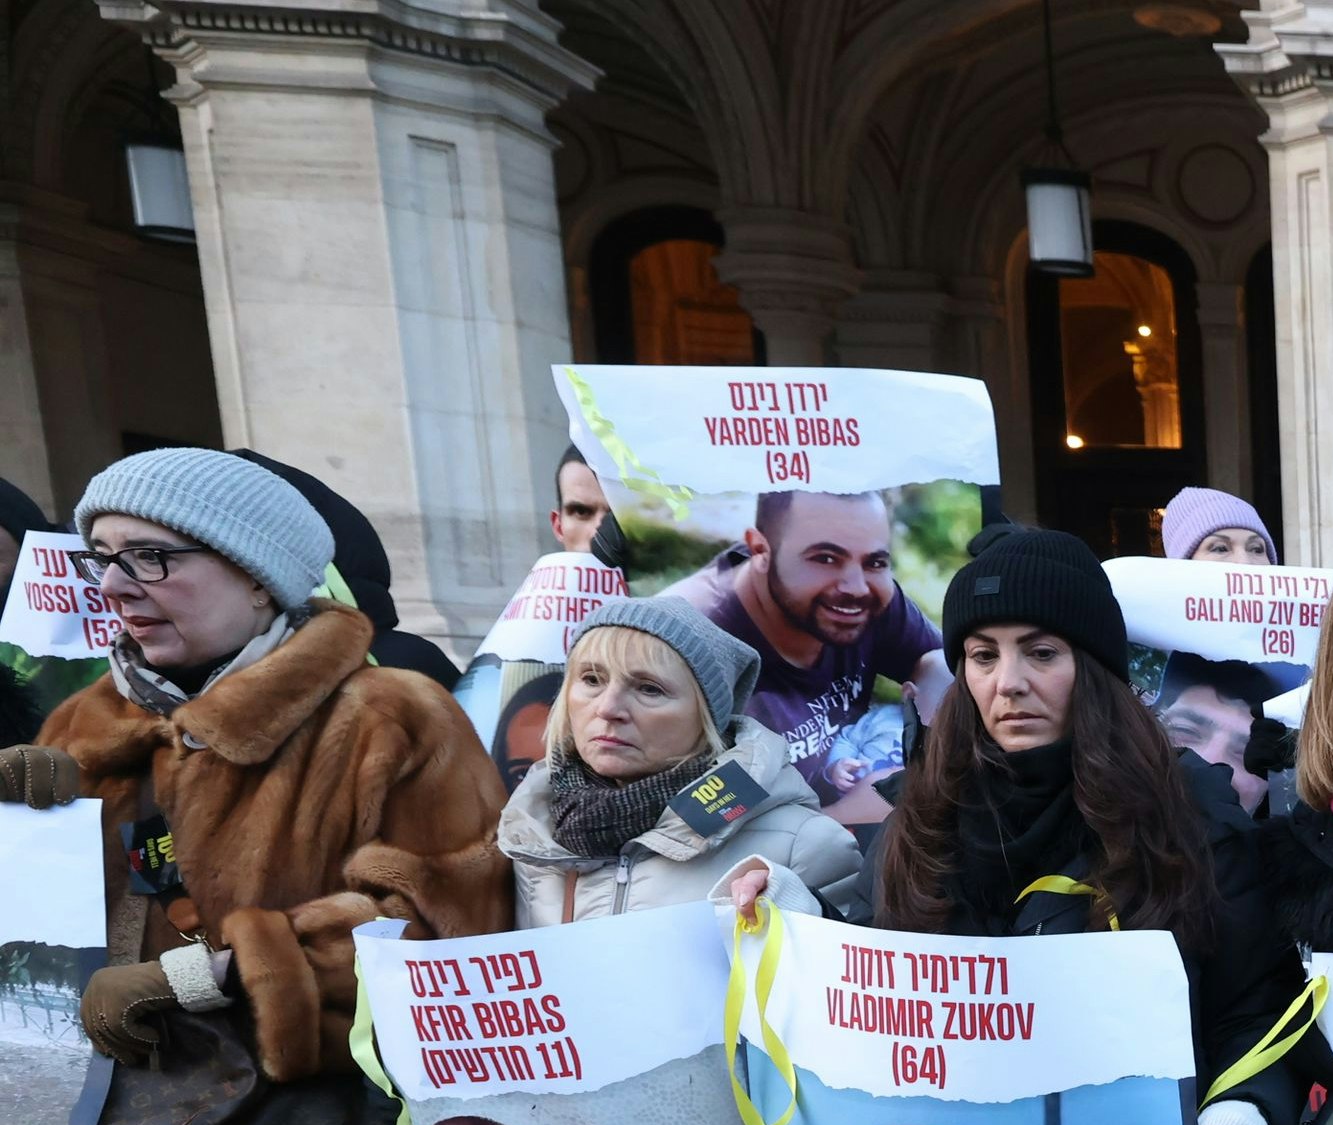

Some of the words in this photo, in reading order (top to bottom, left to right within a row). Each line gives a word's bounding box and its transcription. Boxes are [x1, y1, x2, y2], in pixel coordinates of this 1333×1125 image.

[728, 383, 780, 411] ביבס
[785, 383, 827, 414] ירדן
[704, 417, 789, 446] YARDEN
[796, 418, 860, 446] BIBAS
[766, 450, 810, 484] (34)
[24, 581, 80, 614] YOSSI
[1225, 572, 1264, 596] ברמן
[1303, 576, 1329, 599] גלי
[1185, 597, 1223, 622] GALI
[1229, 599, 1263, 623] AND
[1268, 601, 1295, 625] ZIV
[1262, 627, 1295, 657] (26)
[691, 774, 725, 805] 100
[405, 959, 471, 998] ביבס
[469, 950, 543, 993] כפיר
[841, 943, 896, 992] זוקוב
[902, 953, 1009, 996] ולדימיר
[410, 1004, 474, 1041] KFIR
[472, 994, 566, 1039] BIBAS
[826, 987, 934, 1039] VLADIMIR
[940, 1001, 1035, 1041] ZUKOV
[891, 1045, 947, 1090] (64)
